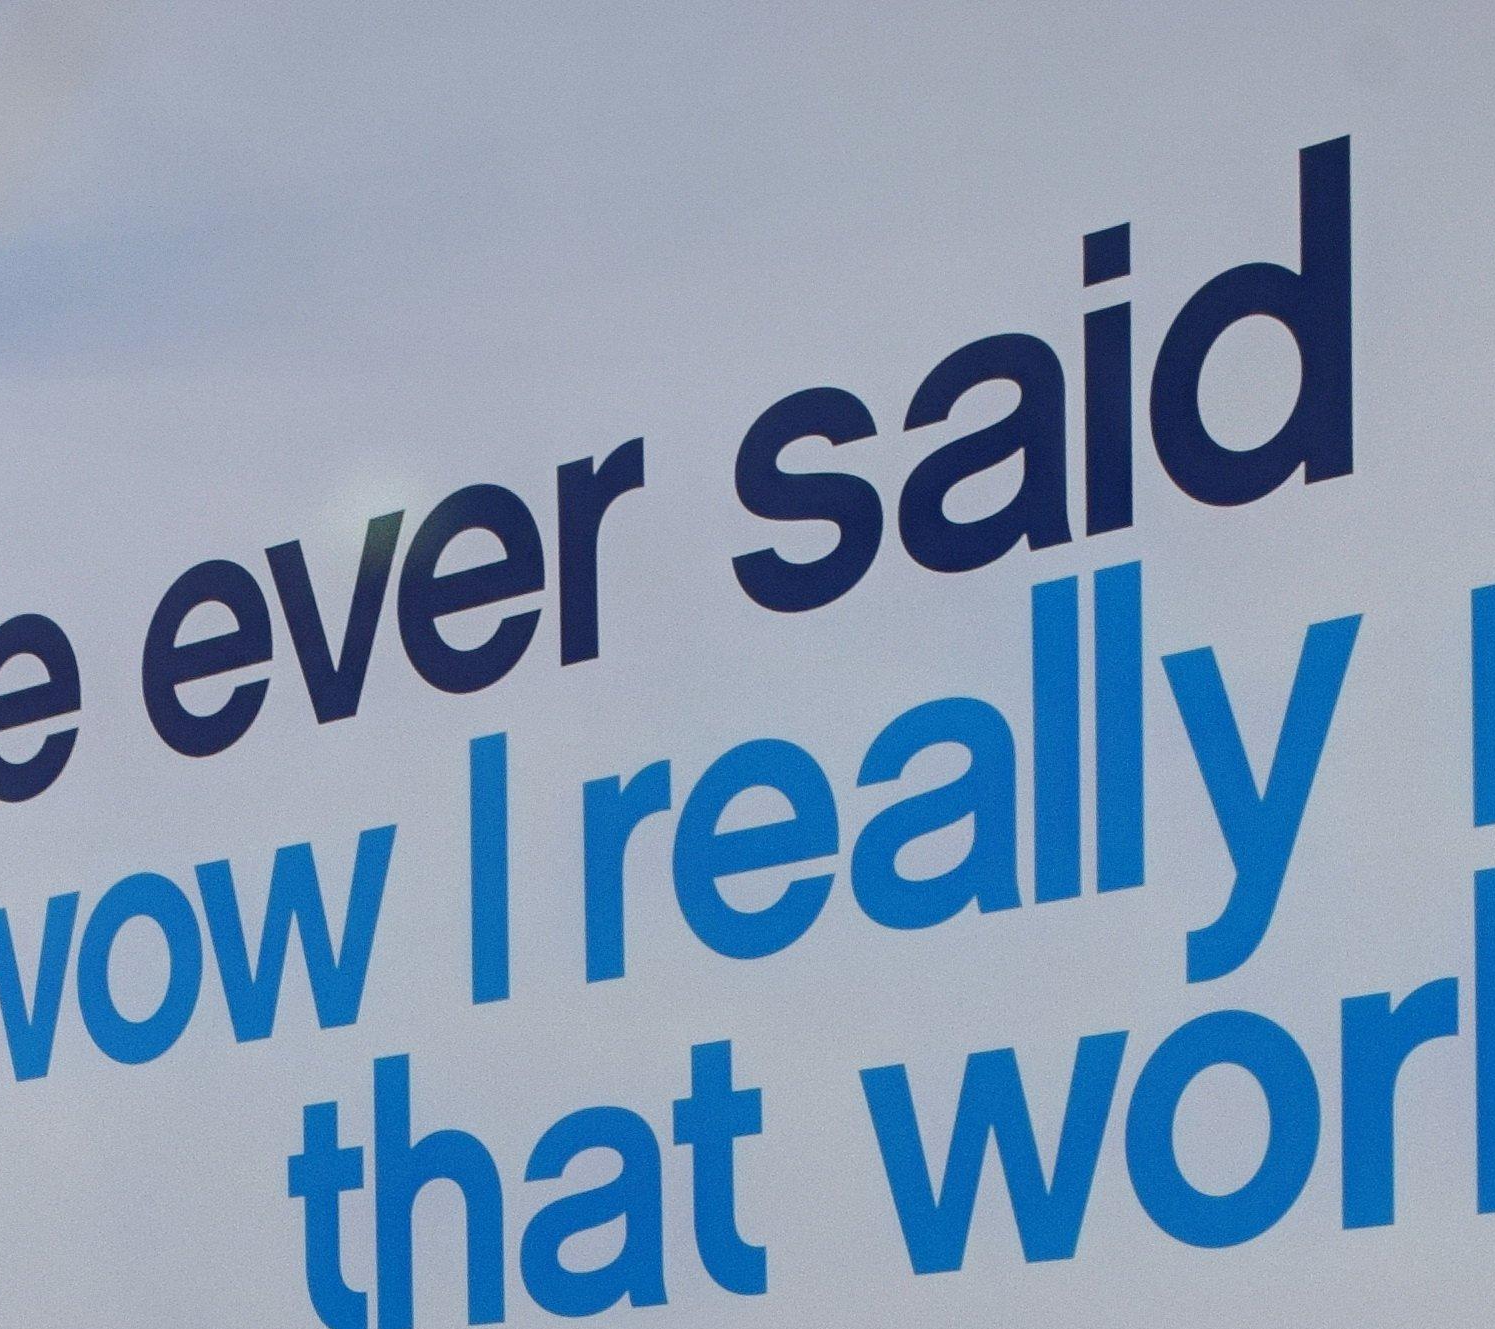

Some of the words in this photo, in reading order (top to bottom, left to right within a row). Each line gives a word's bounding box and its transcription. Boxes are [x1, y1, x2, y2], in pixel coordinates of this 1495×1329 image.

[140, 435, 646, 759] ever
[731, 133, 1355, 613] said
[468, 730, 510, 1006] I
[580, 559, 1364, 985] really
